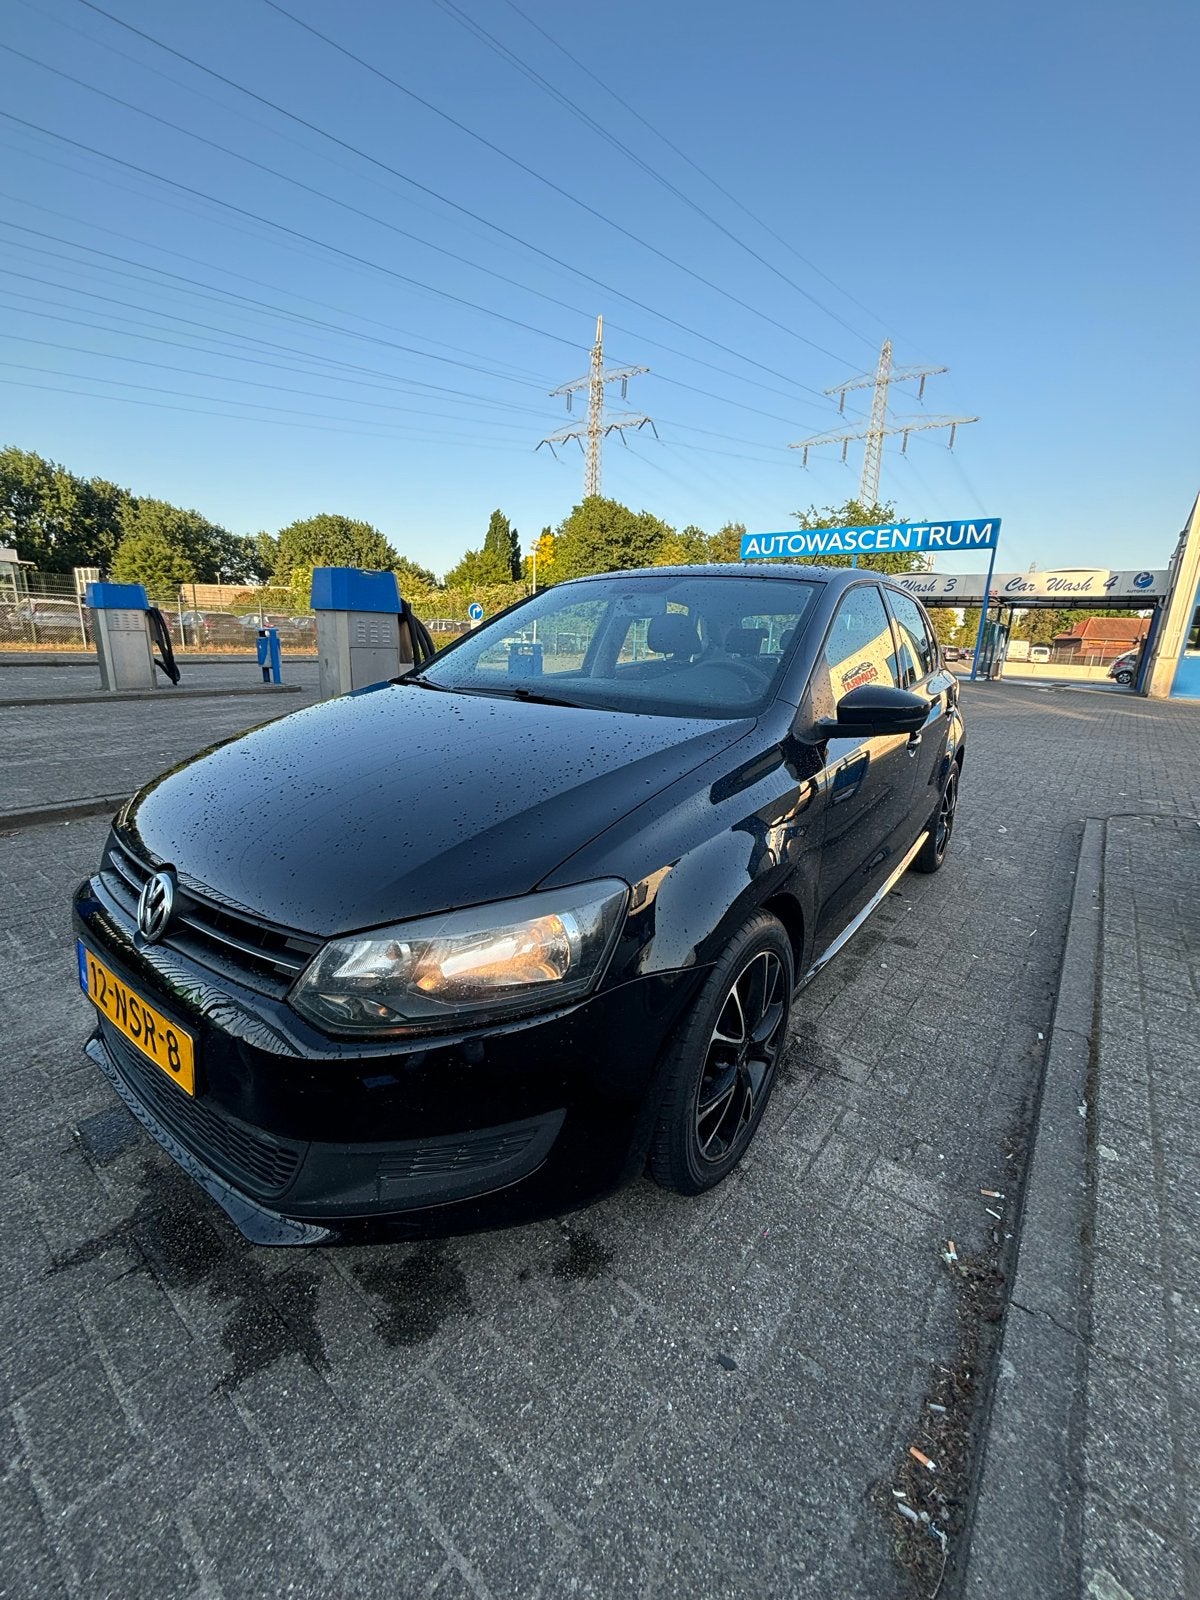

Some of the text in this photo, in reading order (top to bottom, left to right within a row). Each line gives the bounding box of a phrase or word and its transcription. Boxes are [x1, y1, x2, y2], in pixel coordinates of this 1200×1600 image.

[745, 523, 993, 555] AUTOWASCENTRUM
[900, 578, 958, 593] Wash 3
[1004, 575, 1119, 592] Car Wash 4
[91, 961, 181, 1073] 12-NSR-8
